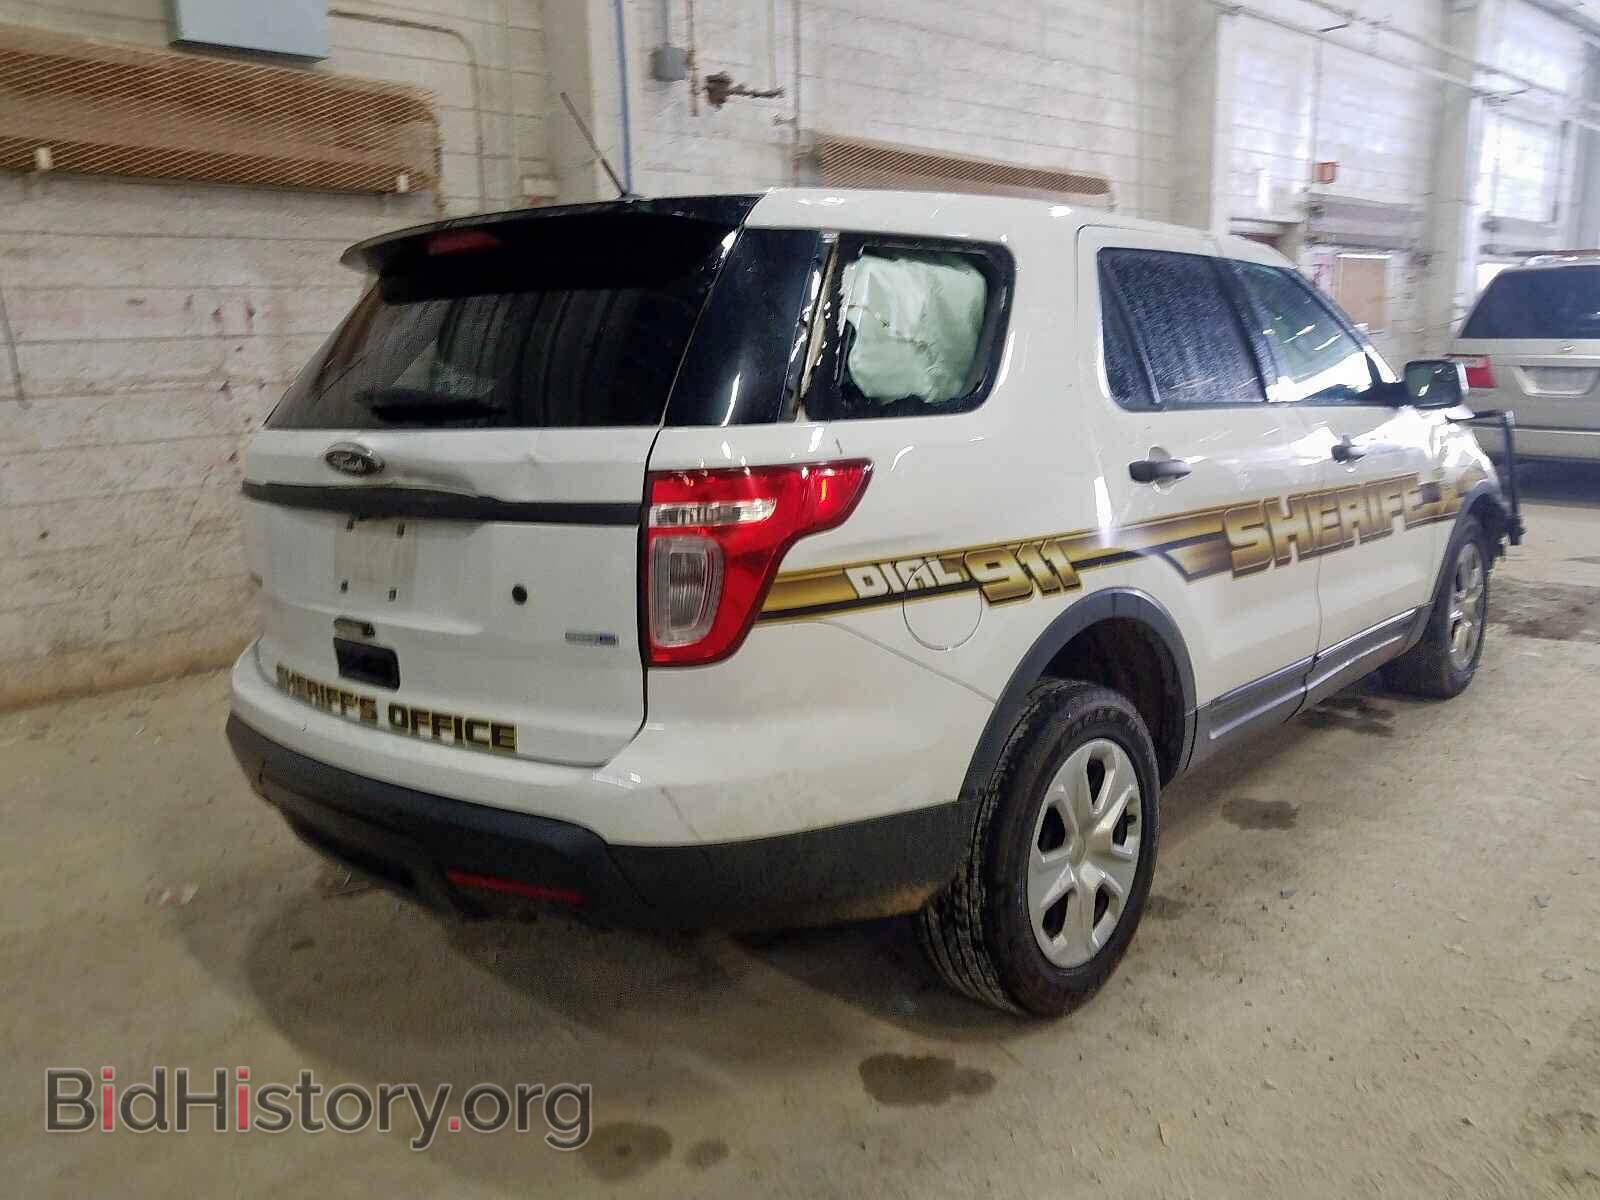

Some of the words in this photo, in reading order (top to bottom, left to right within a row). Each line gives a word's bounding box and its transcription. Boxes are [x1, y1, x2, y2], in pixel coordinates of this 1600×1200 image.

[1224, 473, 1423, 578] SHERIFF
[845, 557, 964, 600] DIAL
[962, 540, 1080, 605] 911
[387, 701, 518, 754] OFFICE
